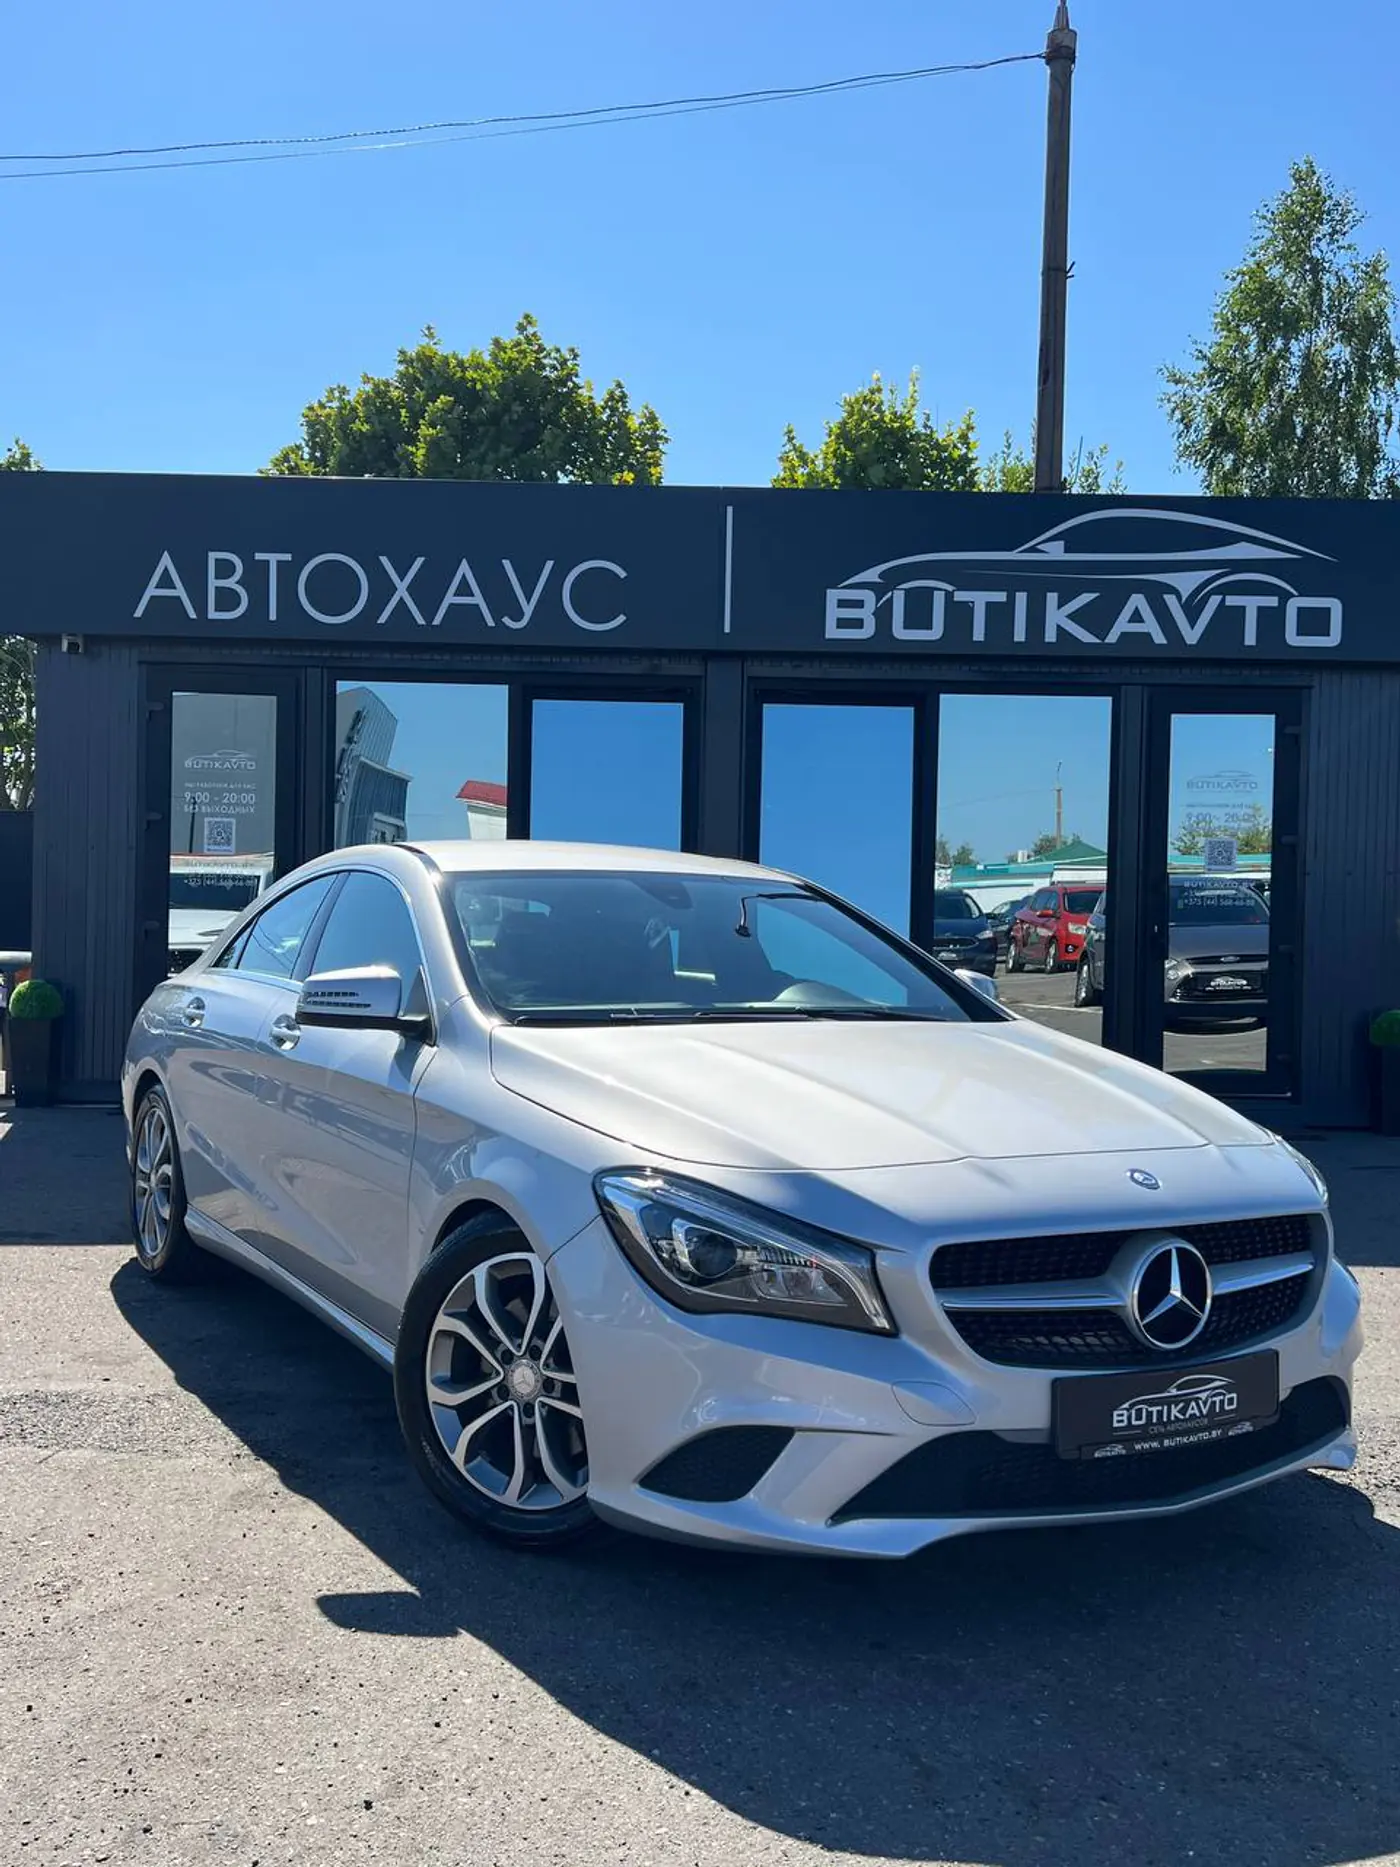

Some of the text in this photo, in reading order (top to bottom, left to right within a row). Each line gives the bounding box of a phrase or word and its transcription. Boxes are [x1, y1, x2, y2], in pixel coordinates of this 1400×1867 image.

[133, 550, 628, 631] АВТОХАУС
[825, 586, 1343, 648] BUTIKAVTO
[184, 792, 210, 803] 9:00
[222, 792, 256, 804] 20:00
[1112, 1393, 1238, 1428] BUTIKAVTO
[1163, 1429, 1223, 1448] BUTIKAVTO.BY
